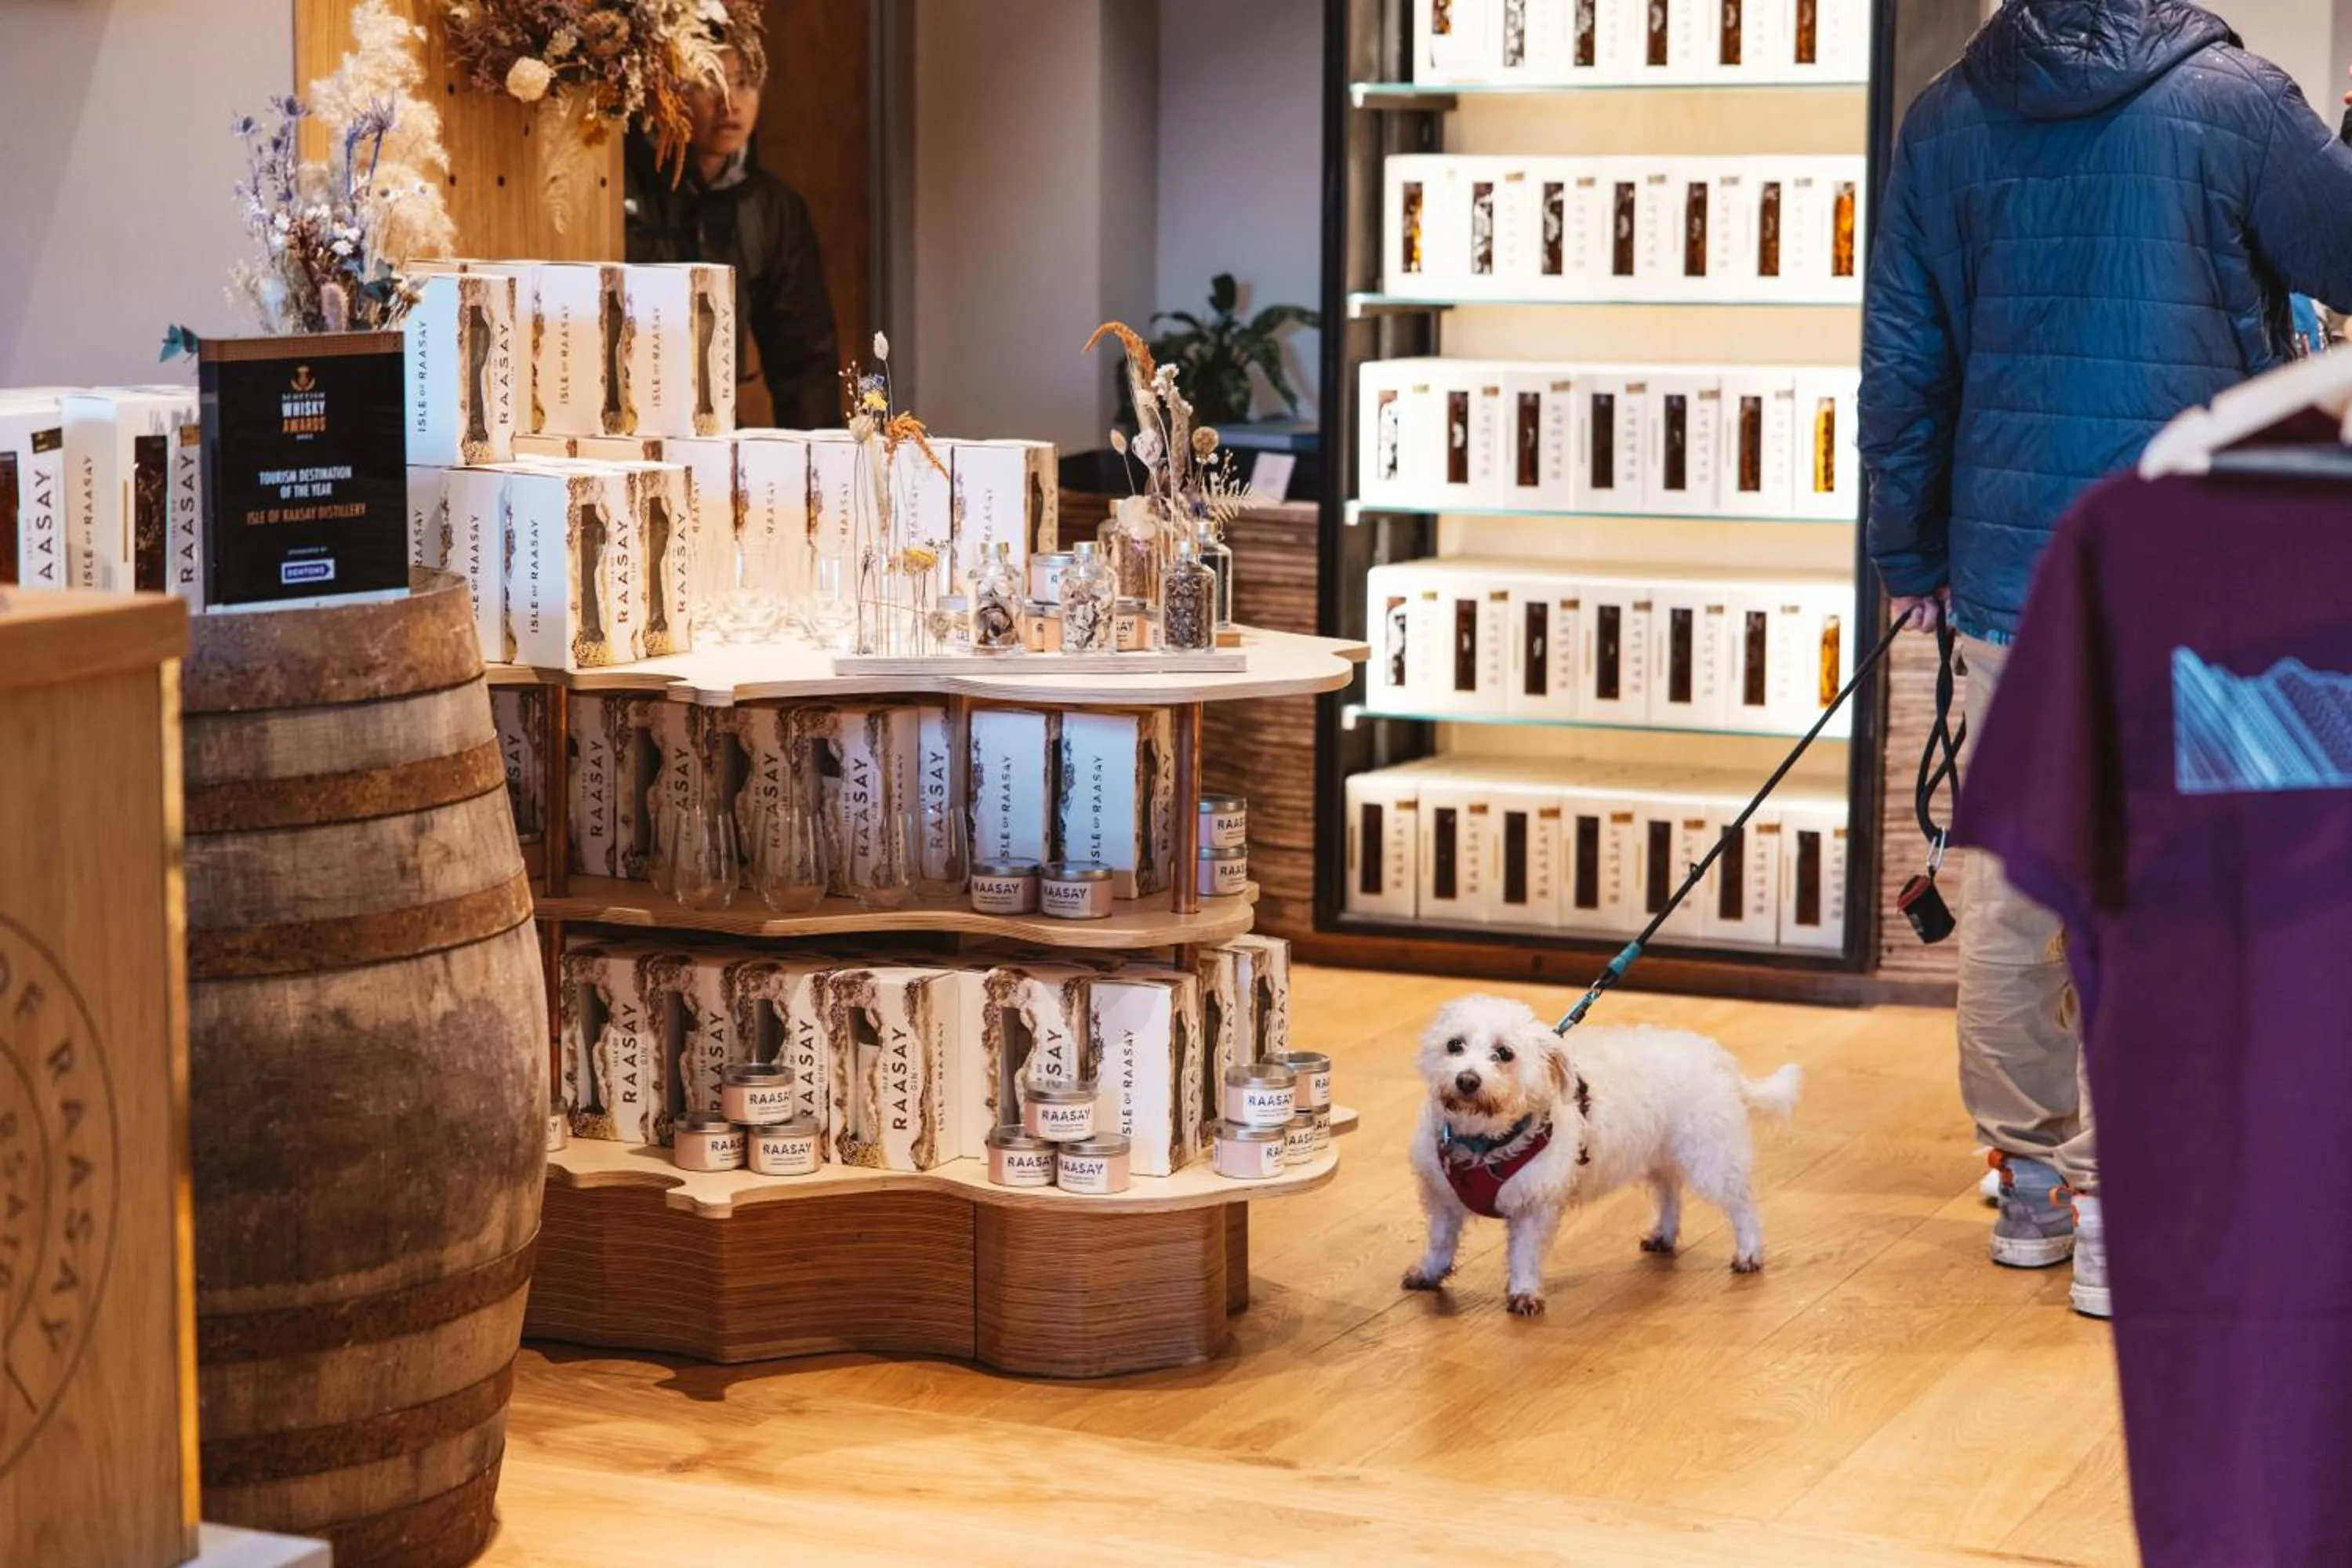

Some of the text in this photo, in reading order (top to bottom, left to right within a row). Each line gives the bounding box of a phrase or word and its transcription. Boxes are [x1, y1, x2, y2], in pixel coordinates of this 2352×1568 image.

[419, 320, 428, 380] RAASAY
[561, 304, 570, 358] RAASAY
[652, 307, 661, 361] RAASAY
[499, 323, 510, 425] RAASAY
[282, 401, 325, 417] WHISKY
[282, 417, 326, 434] AWARDS
[417, 401, 426, 434] ISLE
[83, 456, 93, 524] RAASAY
[259, 466, 351, 485] TOURISM DESTINATION
[280, 482, 332, 499] OF THE YEAR
[34, 470, 54, 580] AASAY
[180, 455, 194, 583] RAASAY
[246, 511, 265, 525] ISLE
[318, 503, 366, 520] DISTILLERY
[415, 510, 424, 568] RAASAY
[83, 551, 93, 586] ISLE
[470, 515, 479, 574] RAASAY
[530, 520, 539, 579] RAASAY
[617, 520, 628, 623] RAASAY
[677, 514, 686, 613] RAASAY
[530, 602, 539, 633] ISLE
[507, 735, 521, 779] SAY
[1002, 756, 1011, 811] RAASAY
[1093, 755, 1102, 812] RAASAY
[590, 741, 603, 837] RAASAY
[853, 758, 869, 857] RAASAY
[930, 752, 945, 848] RAASAY
[1000, 832, 1010, 862] SLE
[622, 1004, 637, 1104] RAASAY
[710, 1011, 724, 1111] RAASAY
[799, 1021, 814, 1118] RAASAY
[892, 1028, 907, 1130] RAASAY
[1046, 1029, 1062, 1076] SAY
[1123, 1029, 1134, 1087] RAASAY
[1042, 1109, 1090, 1122] RAASAY
[1123, 1109, 1133, 1134] SLE
[711, 1138, 741, 1151] RAAS
[763, 1143, 811, 1155] RAASAY
[39, 1038, 95, 1353] RAASAY
